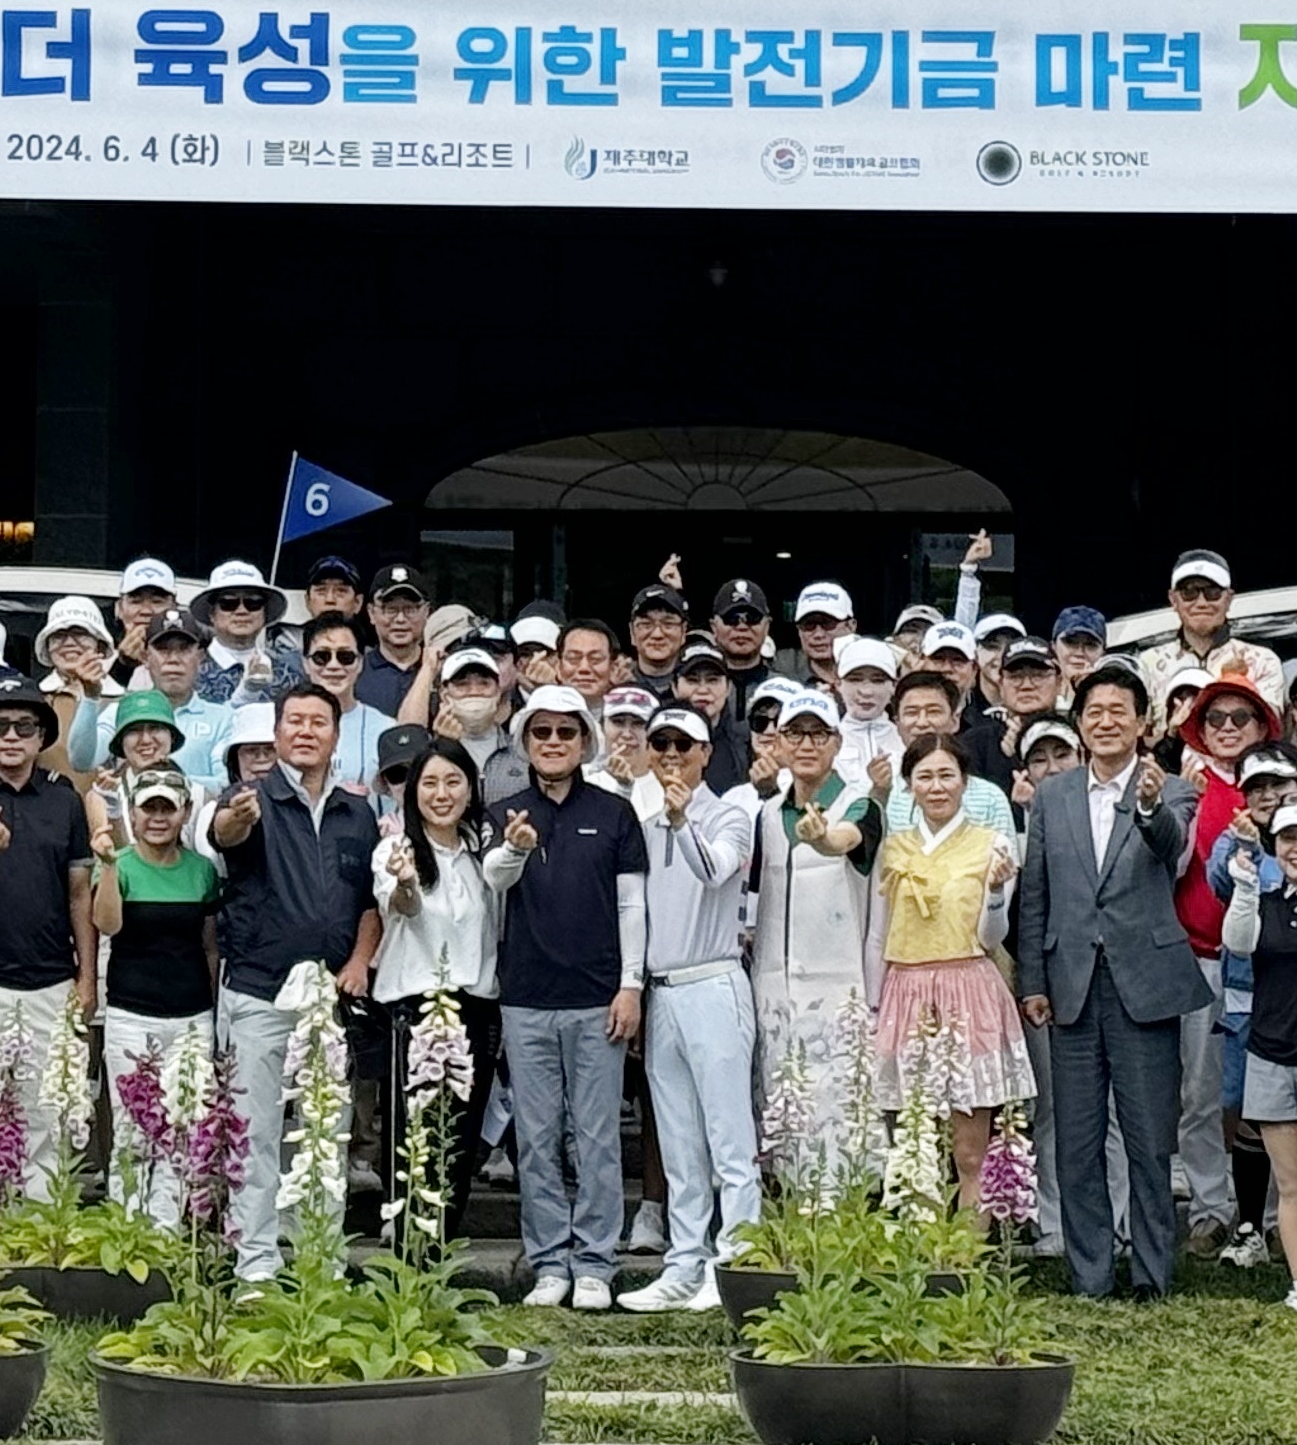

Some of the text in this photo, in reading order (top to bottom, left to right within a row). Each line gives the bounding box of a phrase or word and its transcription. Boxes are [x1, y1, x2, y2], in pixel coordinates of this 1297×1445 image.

[135, 11, 420, 106] 육성을
[455, 26, 627, 107] 위한
[659, 30, 999, 110] 발전기금
[1037, 33, 1202, 112] 마련
[9, 135, 91, 162] 2024.
[142, 138, 159, 163] 4
[172, 135, 220, 167] (화)
[265, 142, 513, 168] 블랙스톤 골프&리조트
[1029, 151, 1149, 166] BLACK STONE
[305, 482, 330, 517] 6
